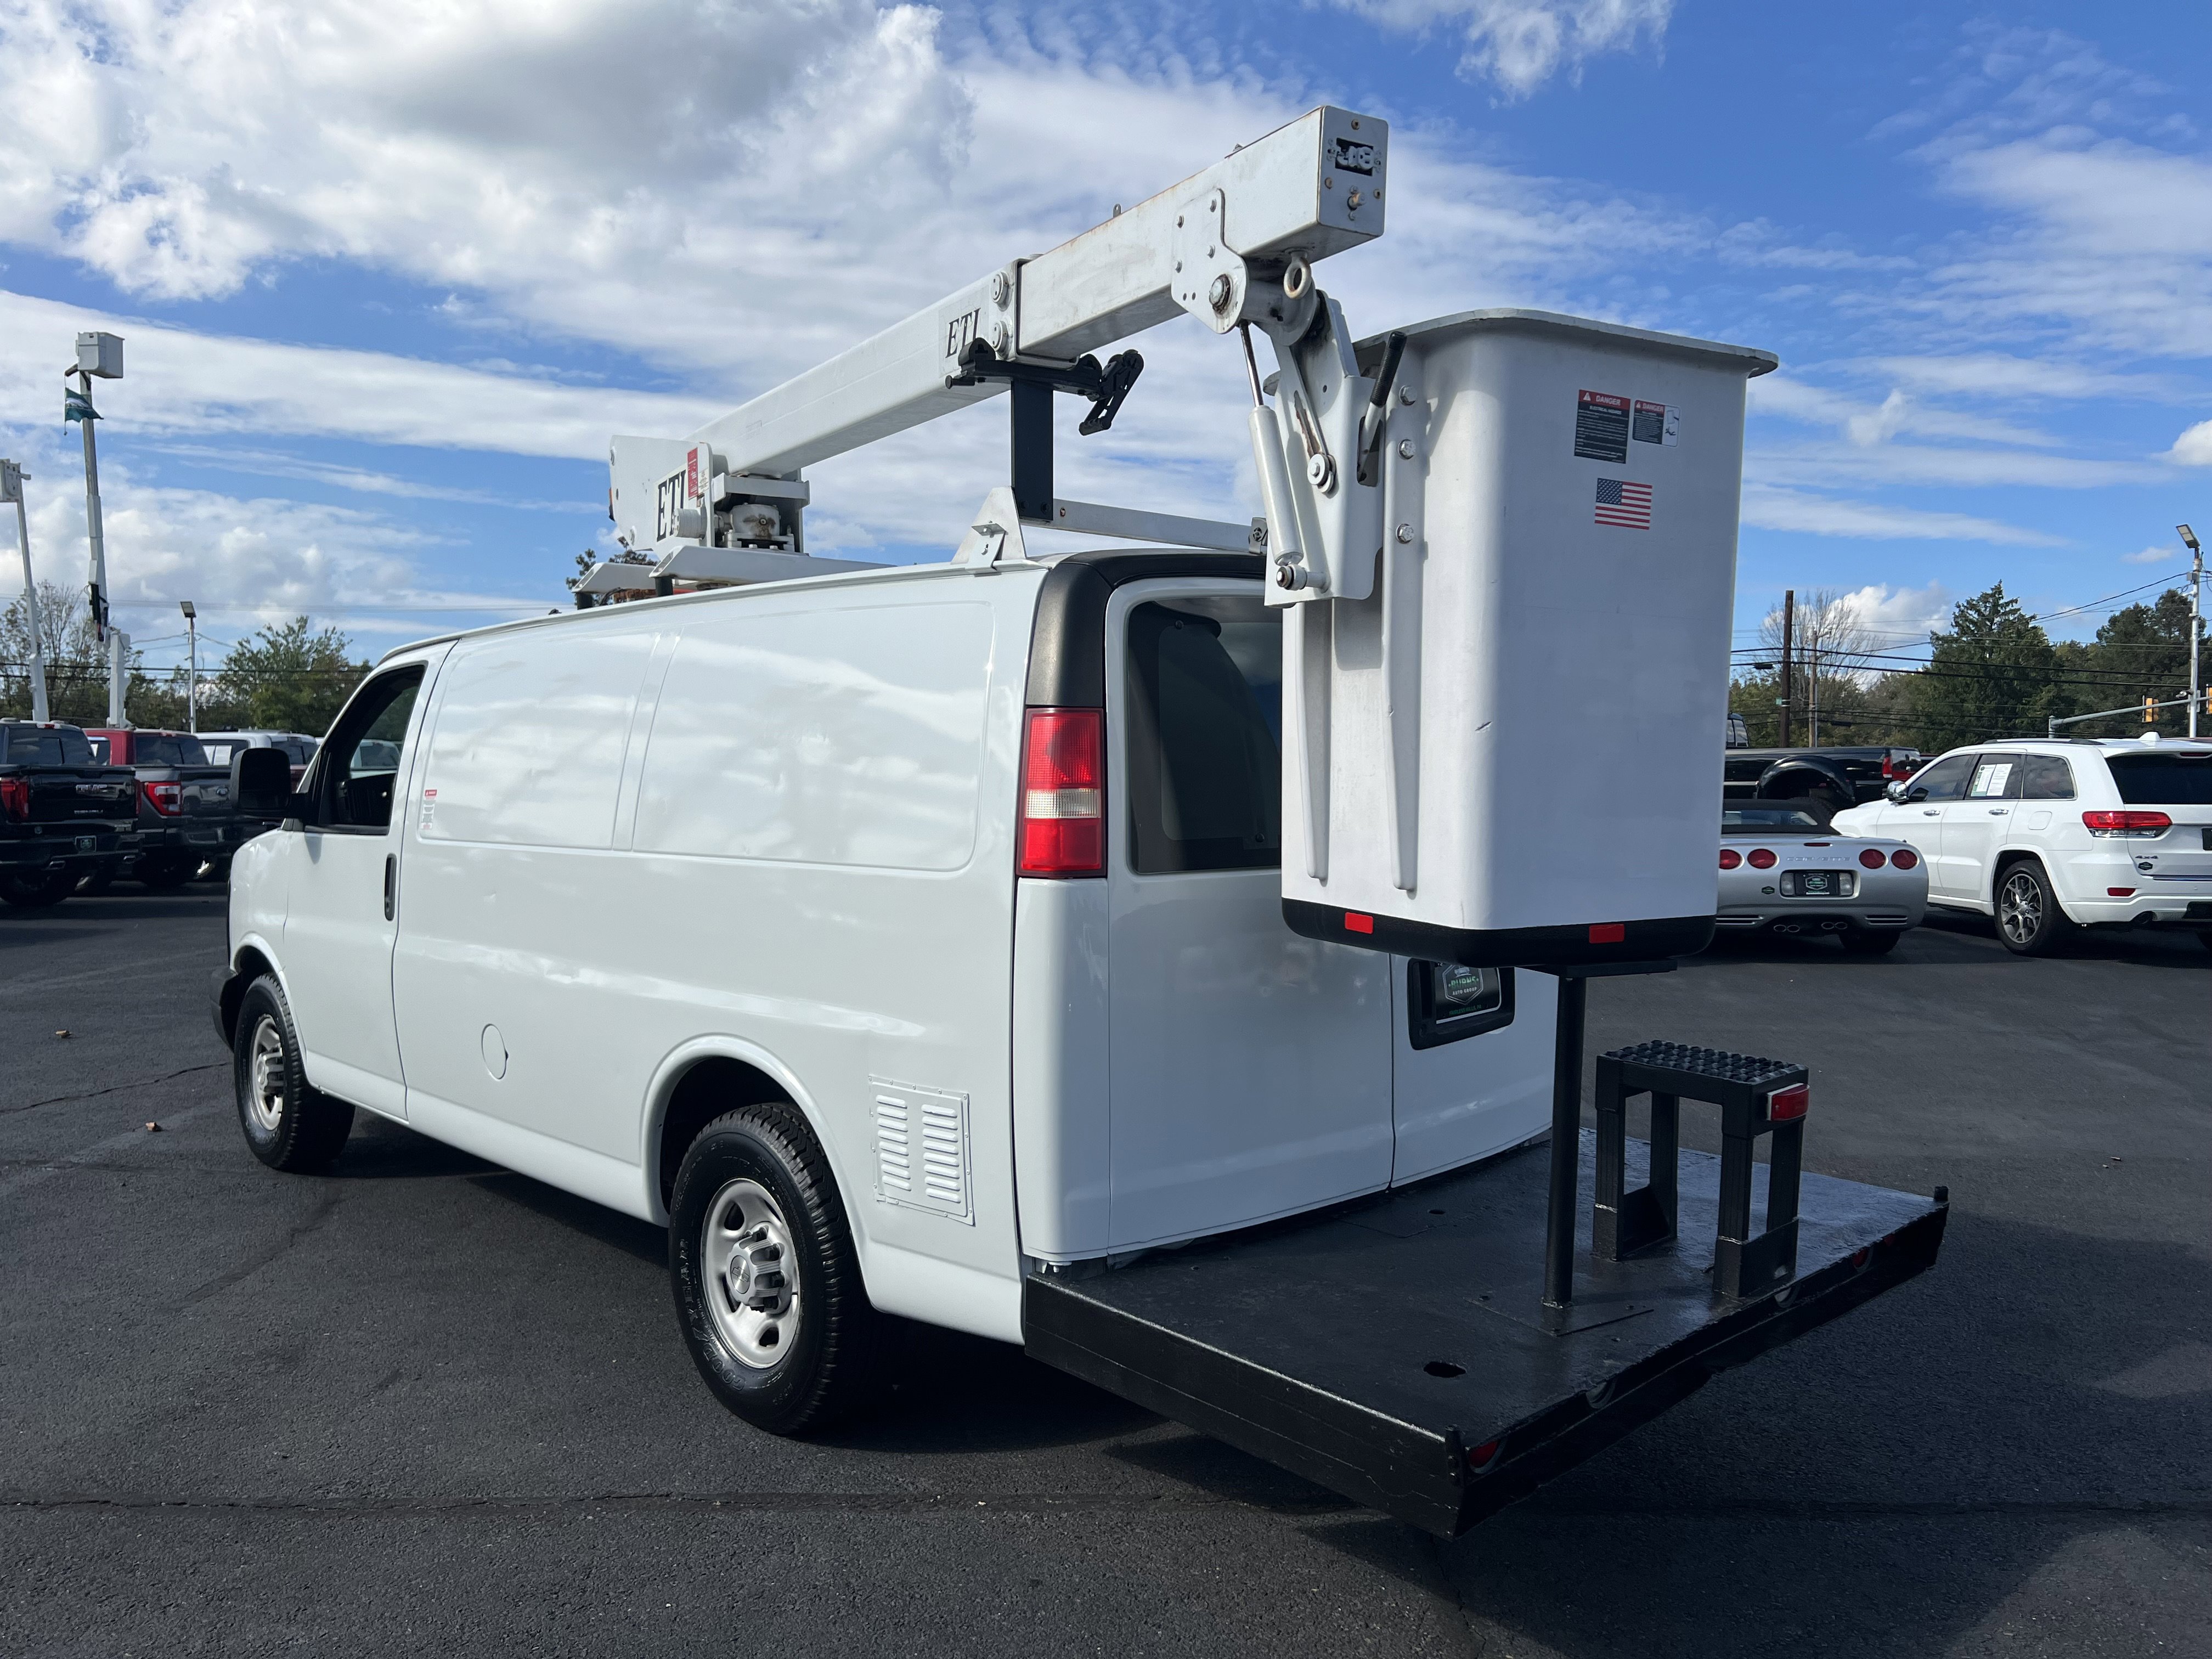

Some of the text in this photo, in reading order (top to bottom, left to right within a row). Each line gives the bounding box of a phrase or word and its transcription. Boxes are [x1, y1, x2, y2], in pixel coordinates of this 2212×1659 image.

[945, 307, 981, 358] ETI
[1595, 395, 1621, 406] DANGER
[1642, 403, 1664, 412] DANGER
[657, 469, 686, 542] ETI
[680, 1239, 746, 1391] GOODYEAR
